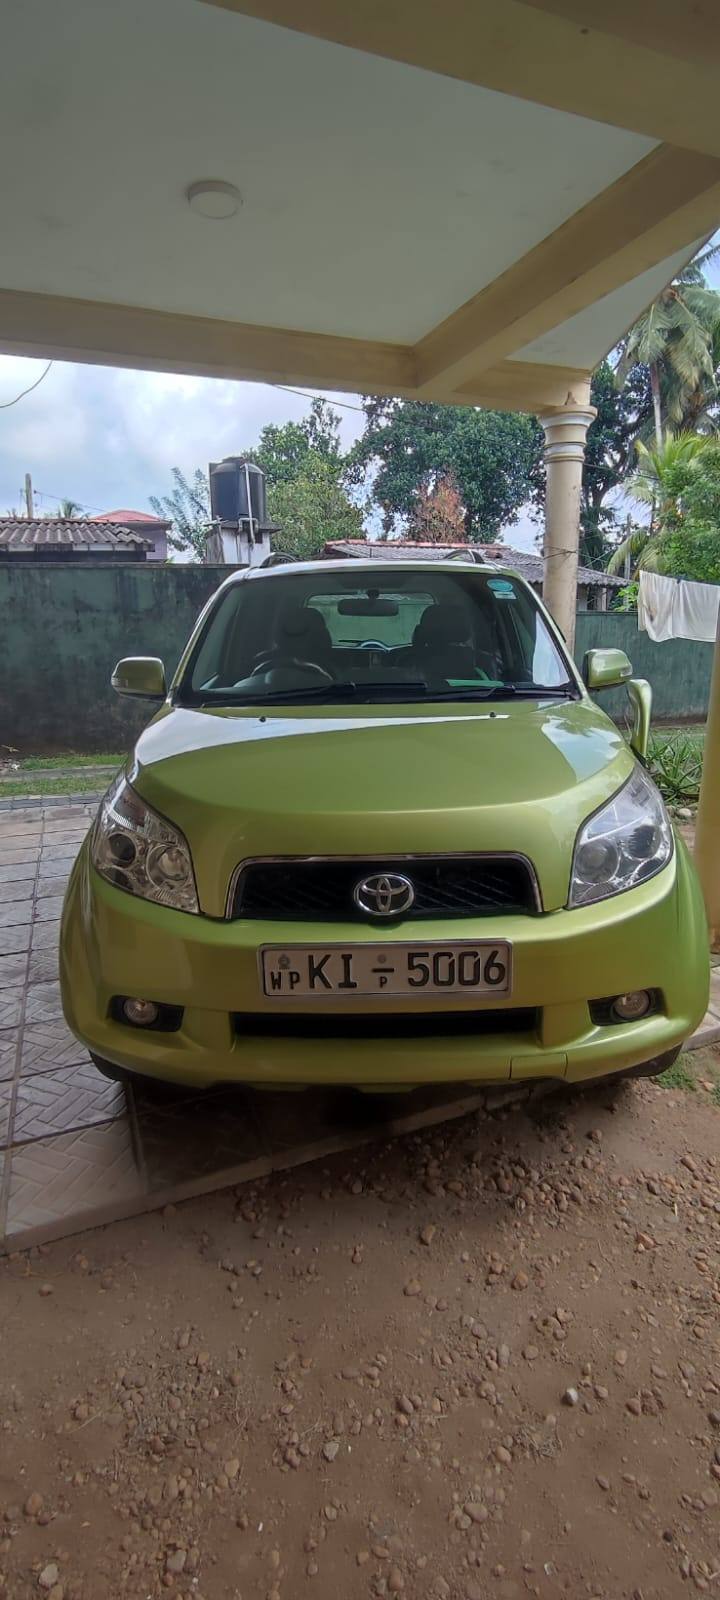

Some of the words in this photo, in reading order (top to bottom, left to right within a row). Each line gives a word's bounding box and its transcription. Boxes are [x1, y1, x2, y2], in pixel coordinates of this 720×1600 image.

[270, 971, 300, 990] WP
[307, 953, 357, 989] KI
[407, 950, 506, 987] 5006
